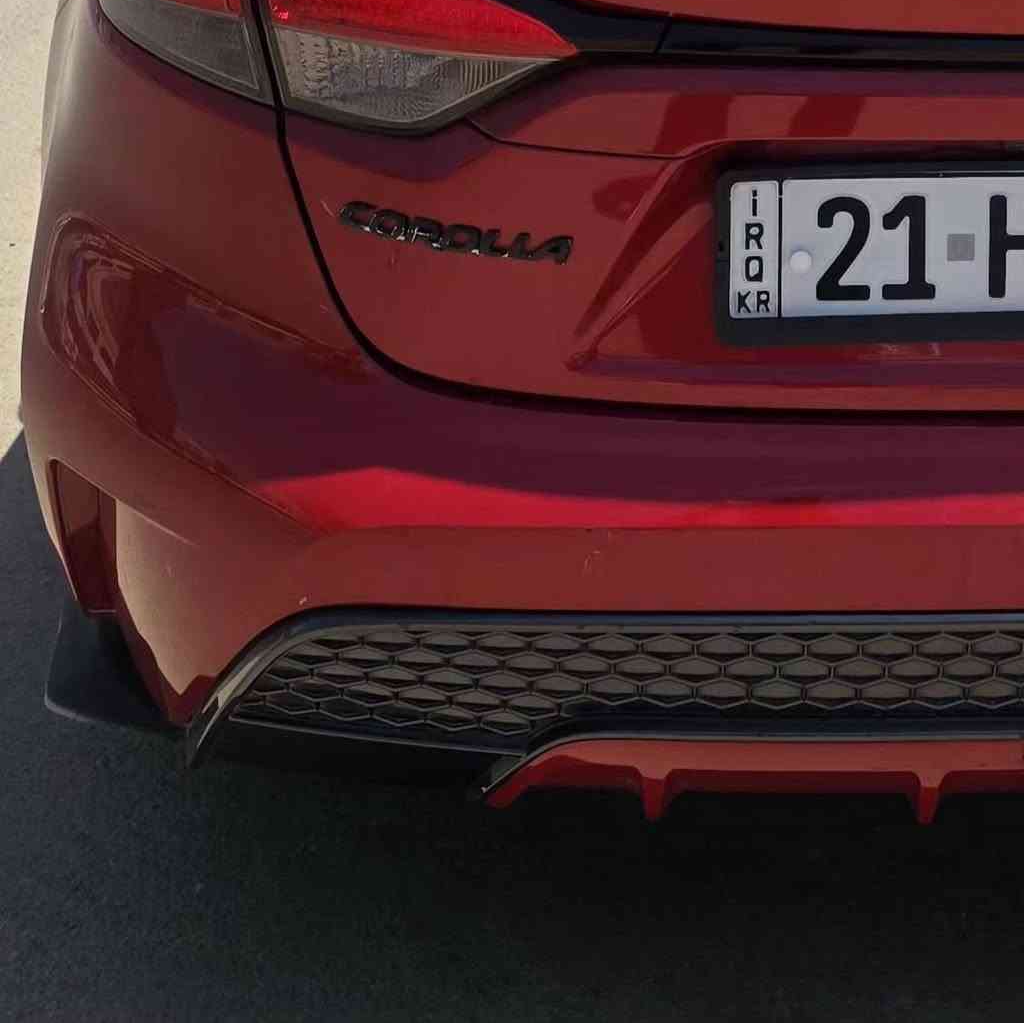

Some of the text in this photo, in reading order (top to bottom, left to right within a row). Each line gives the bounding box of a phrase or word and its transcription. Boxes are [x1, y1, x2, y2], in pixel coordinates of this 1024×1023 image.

[339, 200, 574, 265] COROLLA
[816, 195, 936, 301] 21
[737, 290, 770, 314] KR
